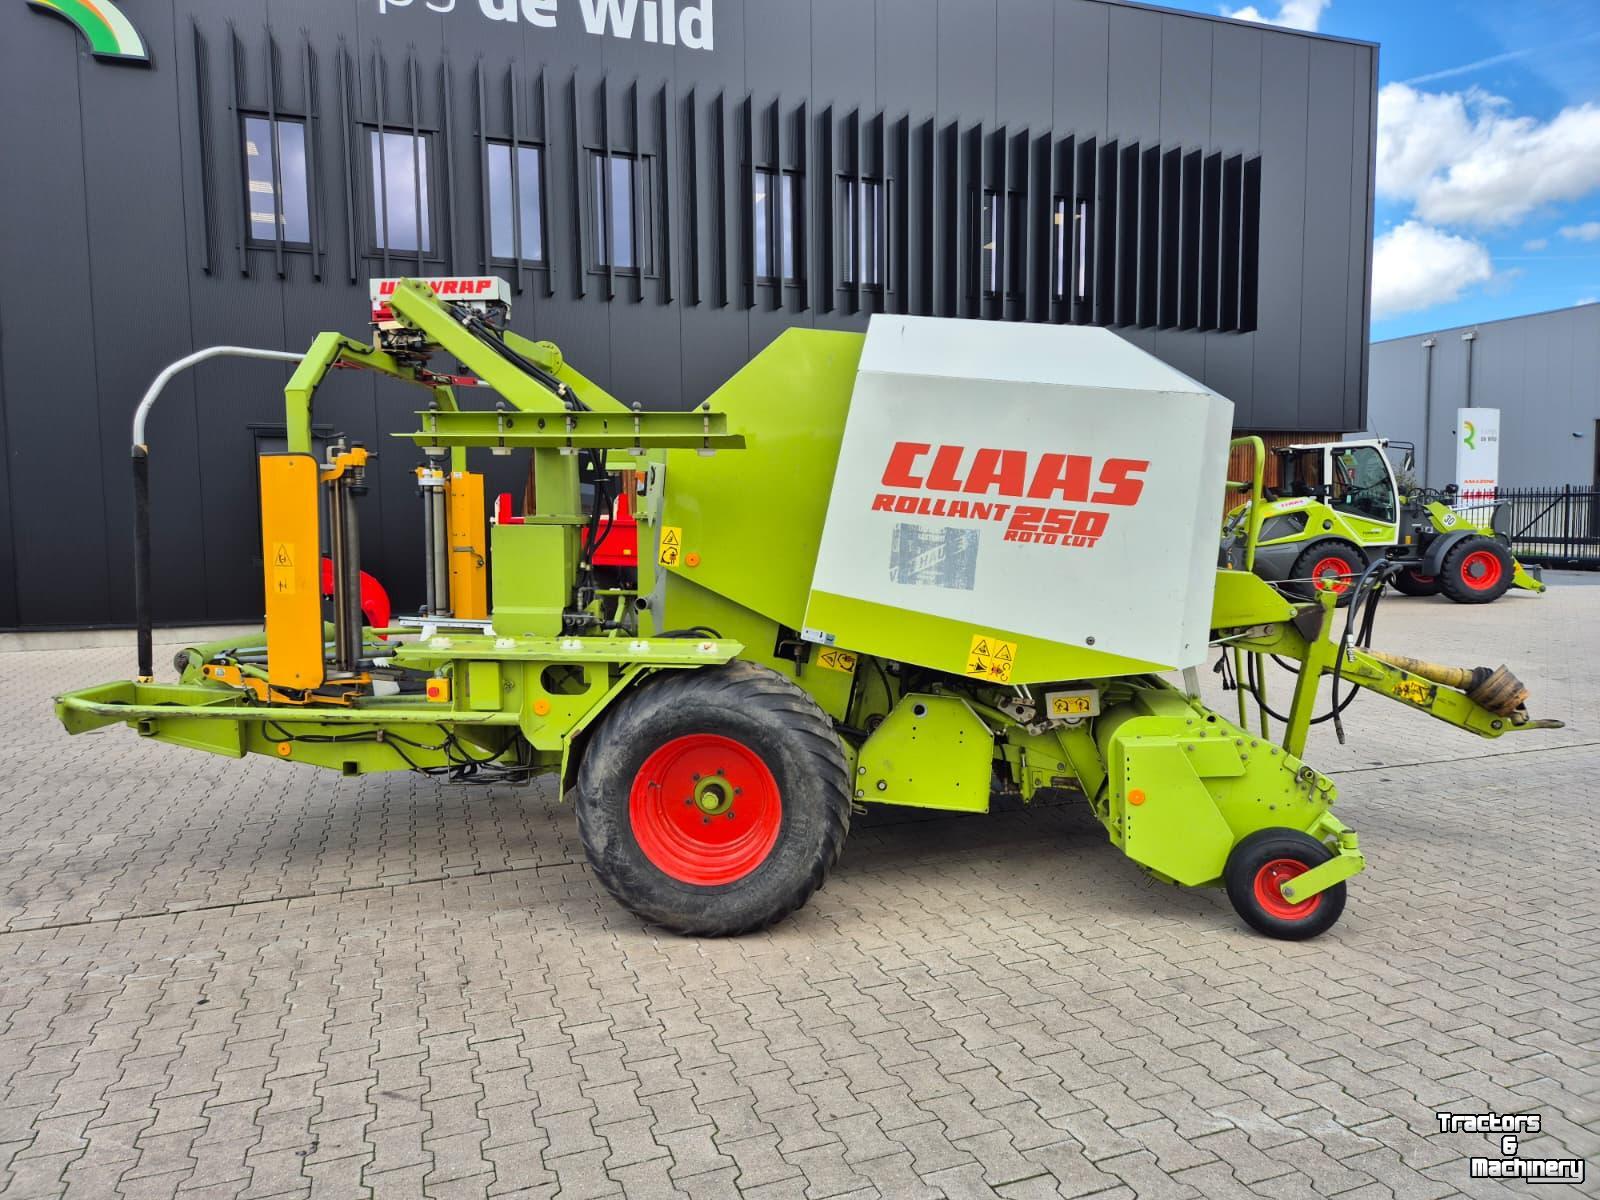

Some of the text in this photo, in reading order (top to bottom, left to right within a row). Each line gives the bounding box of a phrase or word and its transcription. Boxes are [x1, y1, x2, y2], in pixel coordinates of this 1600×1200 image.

[579, 0, 714, 51] Wild
[379, 279, 492, 295] UWRAP
[881, 441, 1150, 506] CLAAS
[871, 494, 1110, 537] ROLLANT 250
[1443, 514, 1456, 525] 30
[1003, 528, 1099, 548] ROTO CUT
